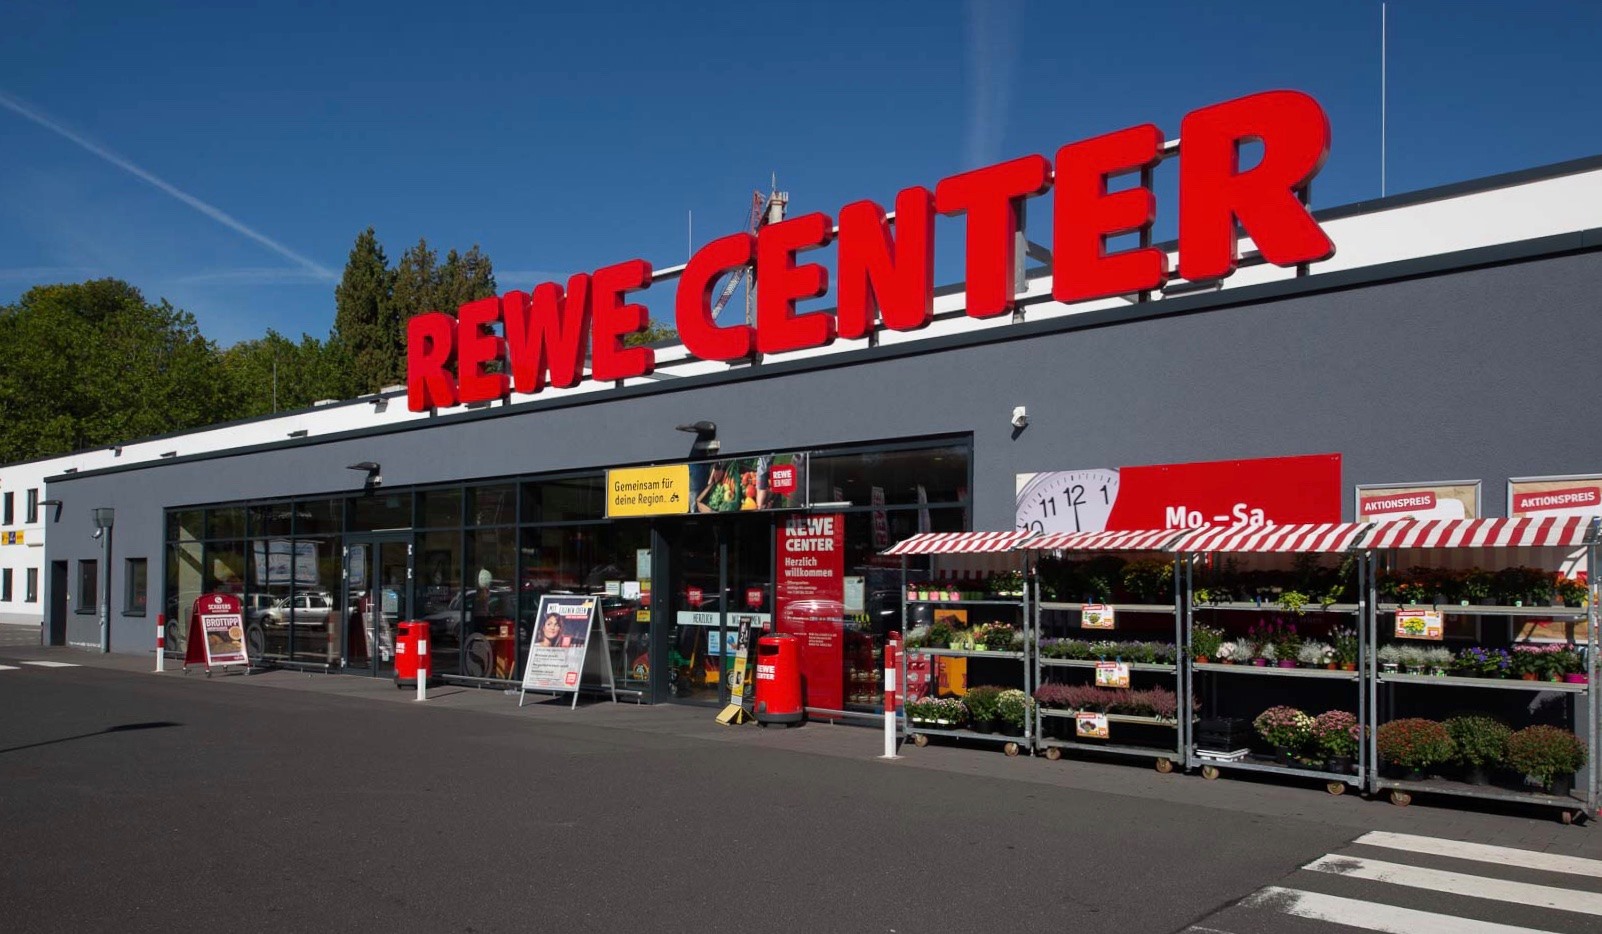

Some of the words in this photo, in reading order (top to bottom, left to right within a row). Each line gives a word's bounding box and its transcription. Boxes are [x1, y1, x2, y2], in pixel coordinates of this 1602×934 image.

[407, 258, 655, 412] REWE
[675, 90, 1336, 361] CENTER
[773, 469, 792, 479] REWE
[614, 480, 660, 492] Gemeinsam
[661, 478, 673, 489] für
[614, 494, 635, 505] deine
[1063, 484, 1086, 507] 12
[1099, 485, 1109, 505] 1
[1520, 491, 1596, 508] AKTIONSPREIS
[1039, 496, 1056, 518] 11
[1364, 495, 1431, 512] AKTIONSPREIS
[785, 517, 834, 536] REWE
[785, 538, 834, 552] CENTER
[784, 556, 818, 567] Herzlich
[784, 567, 833, 577] willkommen
[206, 618, 239, 627] BROTTIPP
[693, 614, 713, 624] HERZLICH
